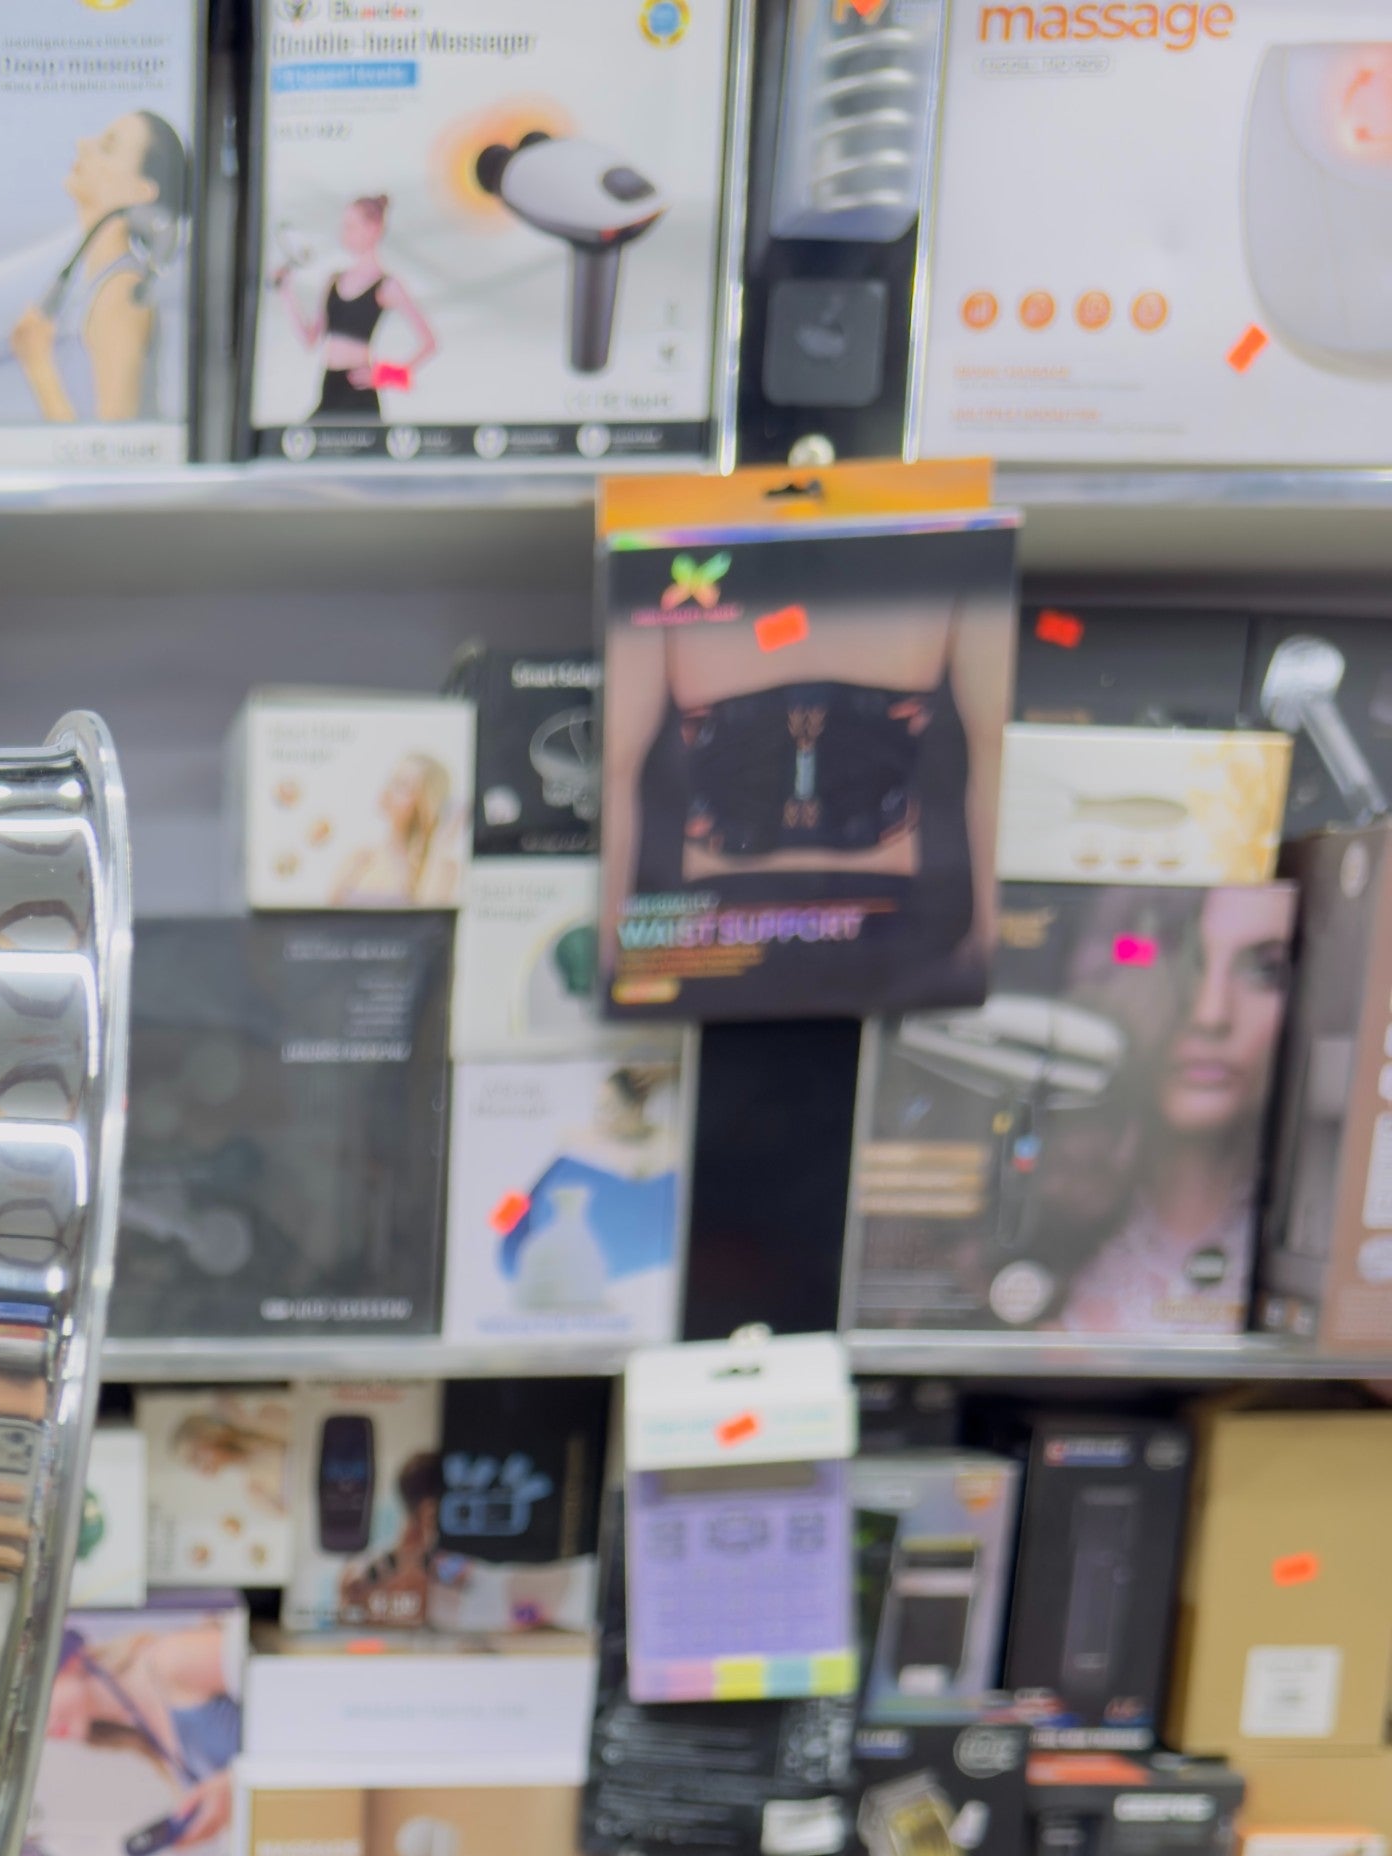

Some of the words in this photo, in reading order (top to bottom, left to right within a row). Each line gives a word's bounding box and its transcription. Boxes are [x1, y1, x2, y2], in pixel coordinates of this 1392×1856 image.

[979, 0, 1236, 51] massage
[615, 914, 716, 950] WAIST
[717, 906, 866, 946] SUPPORT
